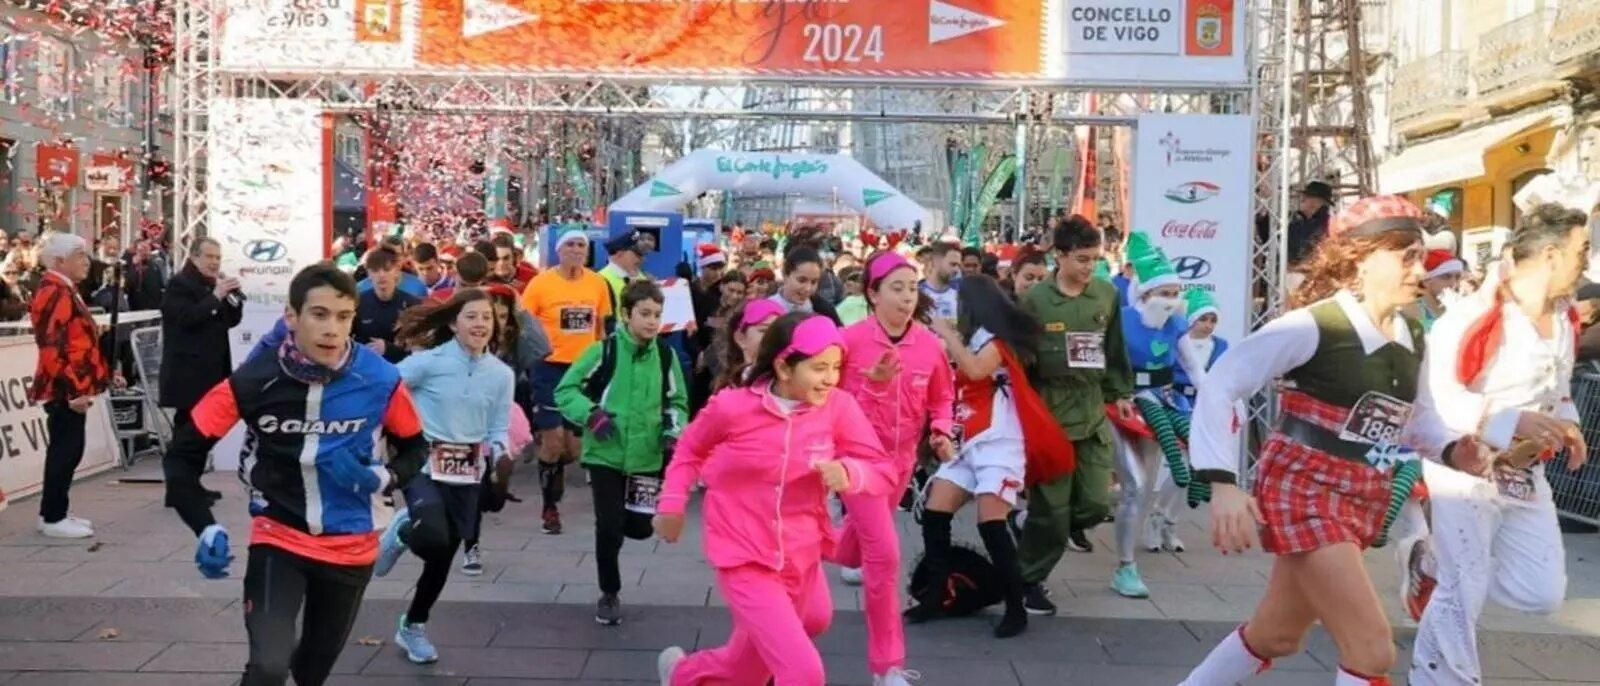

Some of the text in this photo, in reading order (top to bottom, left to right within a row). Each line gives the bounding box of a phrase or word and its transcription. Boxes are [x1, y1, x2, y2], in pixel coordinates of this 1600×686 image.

[1072, 7, 1171, 22] CONCELLO
[1083, 27, 1159, 41] DE VIGO
[803, 24, 884, 63] 2024
[280, 418, 368, 434] GIANT
[22, 417, 50, 451] VI
[440, 459, 470, 474] 1214
